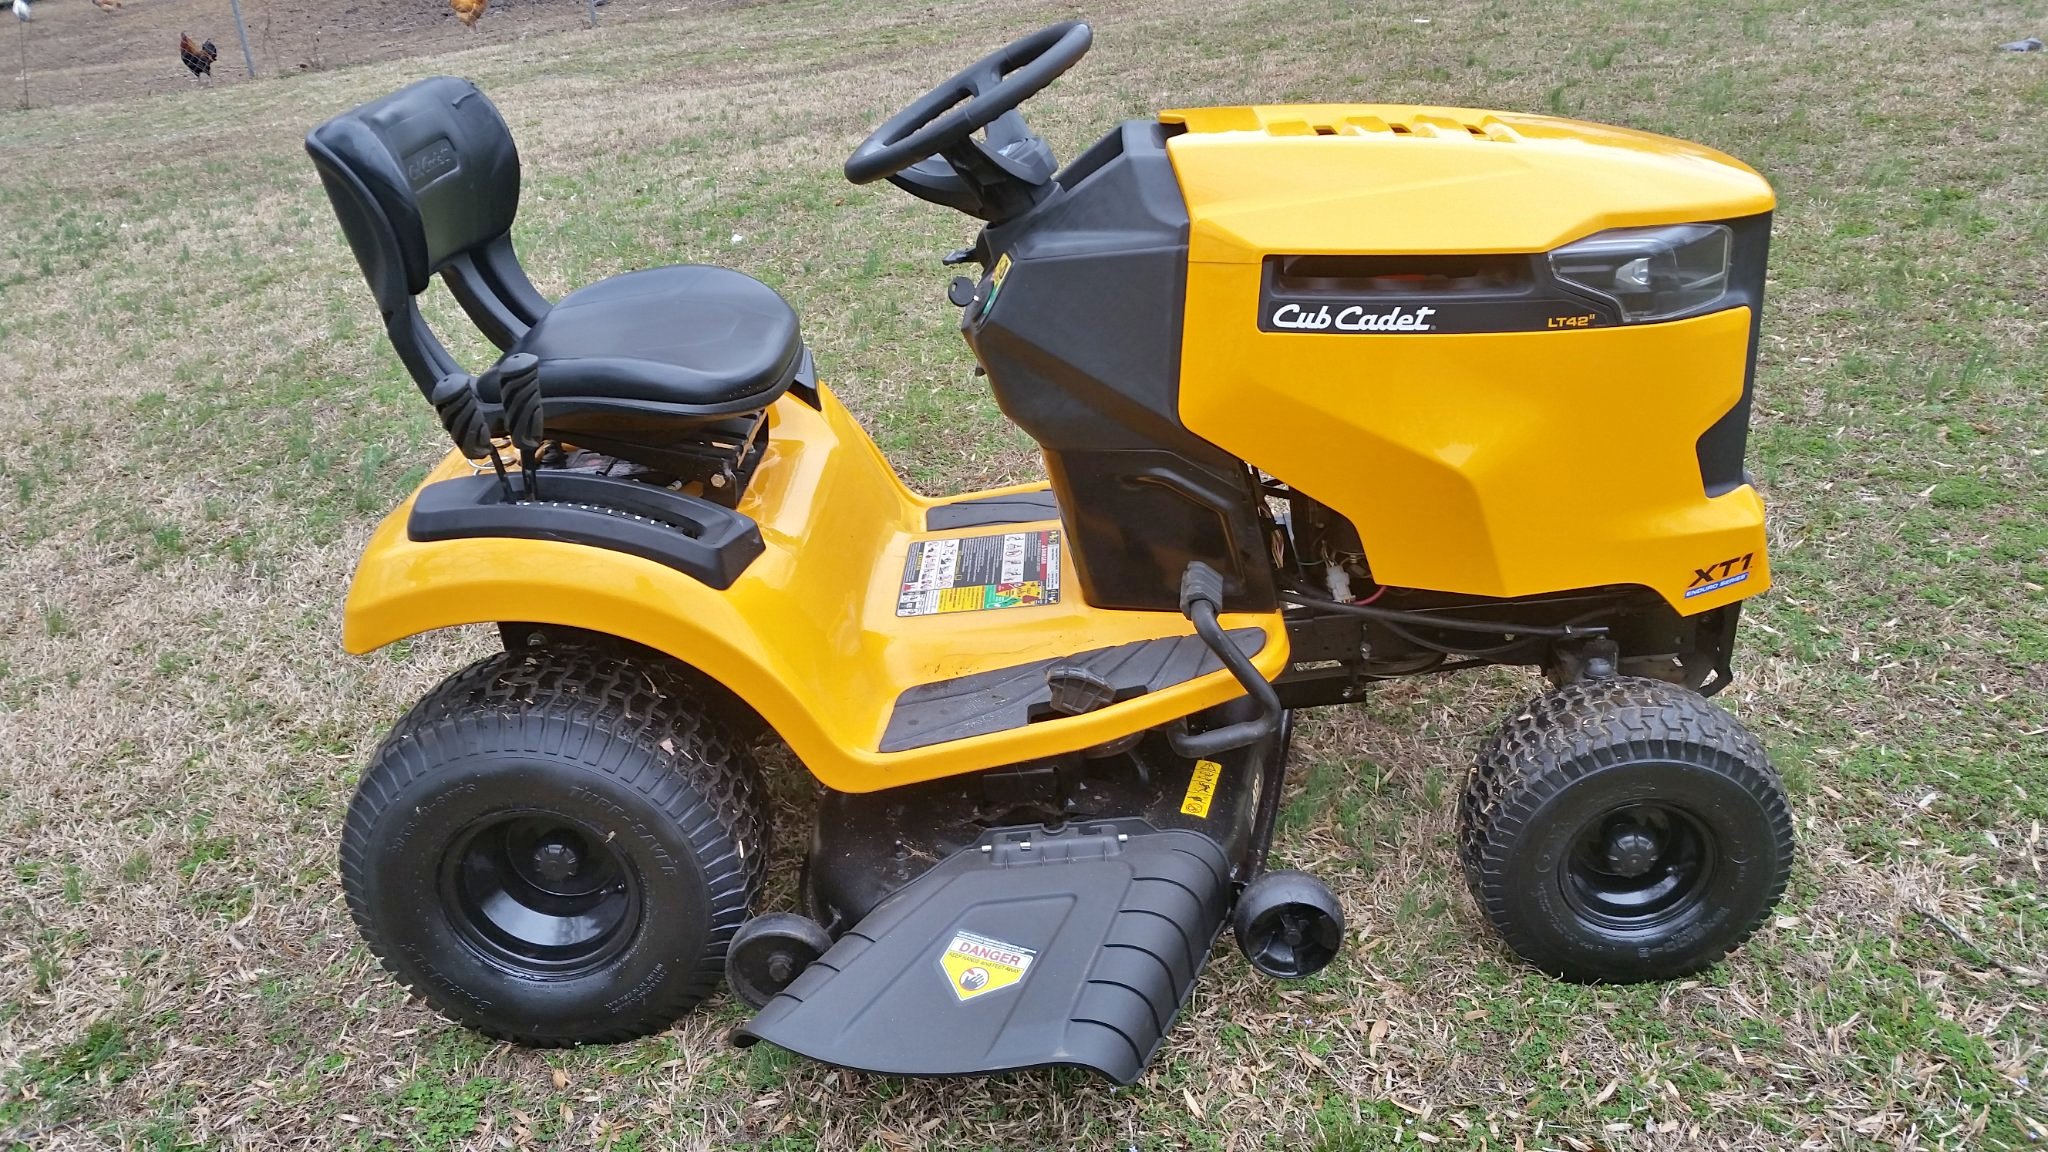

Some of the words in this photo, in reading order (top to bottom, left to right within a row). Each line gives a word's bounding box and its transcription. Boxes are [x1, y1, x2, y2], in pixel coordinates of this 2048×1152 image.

[1272, 303, 1332, 329] Cub
[1334, 305, 1437, 331] Cadet
[1548, 313, 1596, 328] LT42"
[1688, 552, 1754, 588] XT1
[959, 942, 1021, 966] DANGER
